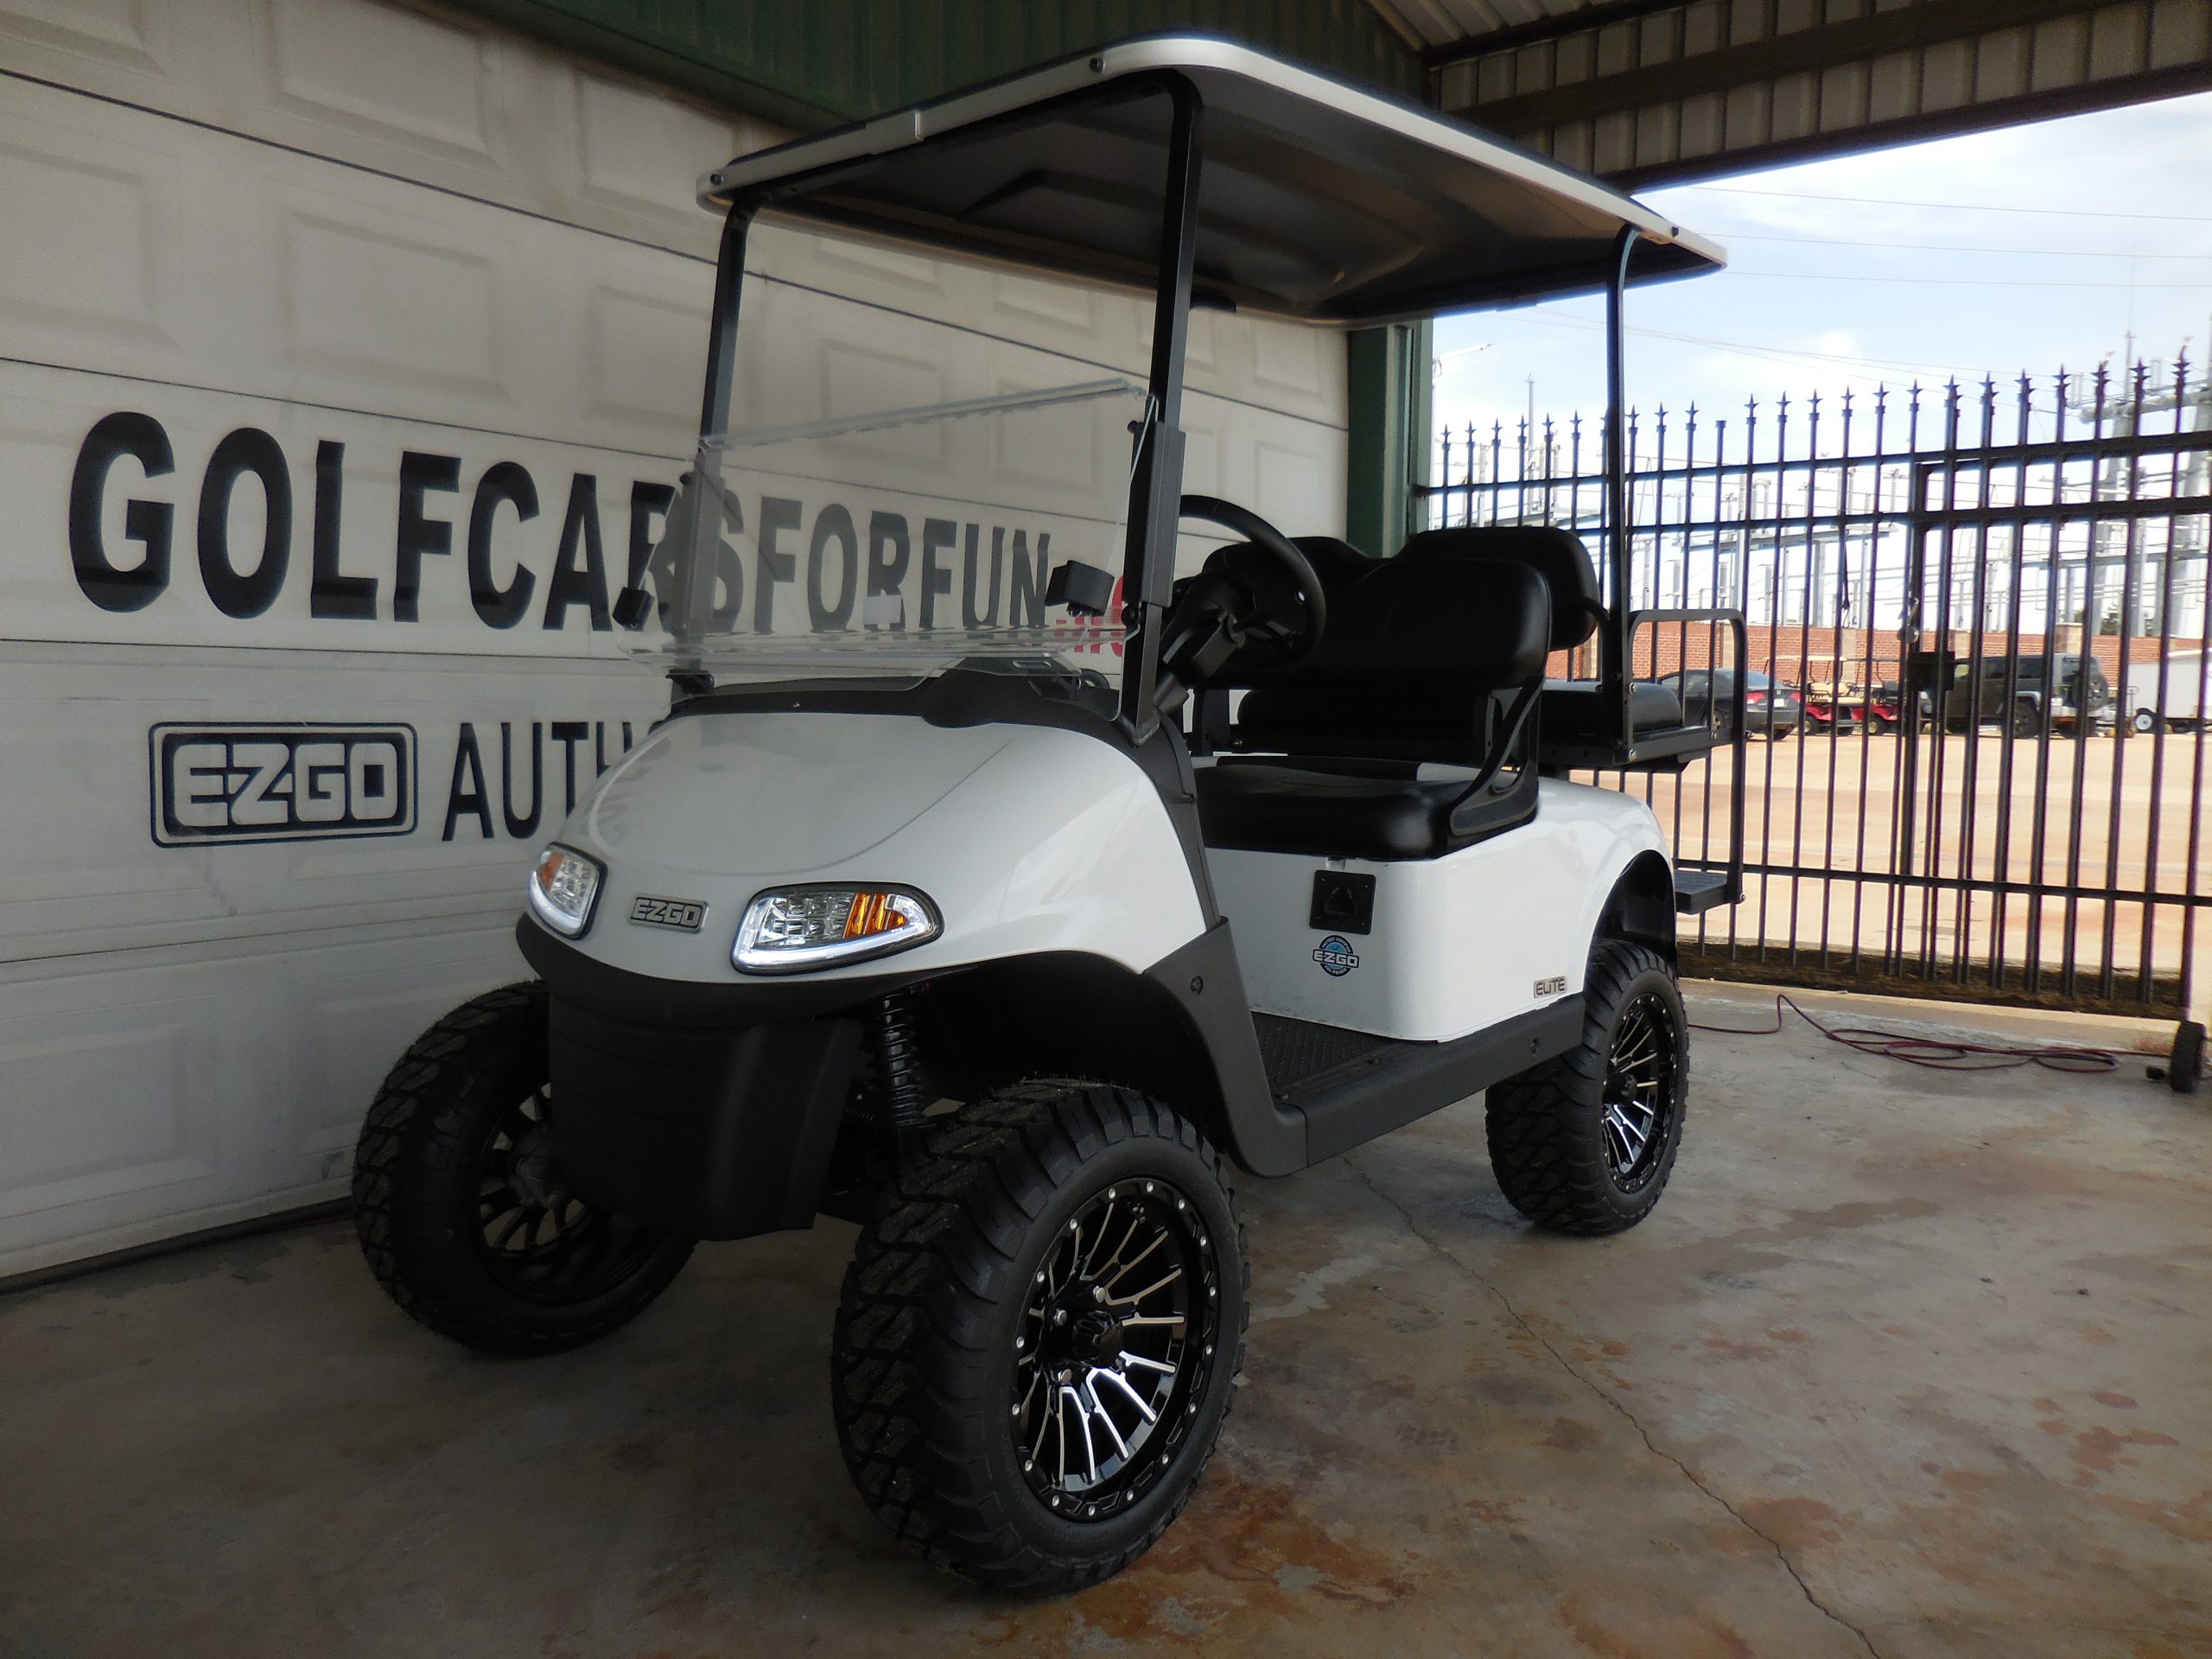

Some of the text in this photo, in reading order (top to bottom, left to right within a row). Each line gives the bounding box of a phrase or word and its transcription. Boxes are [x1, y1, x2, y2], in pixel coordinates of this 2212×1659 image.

[170, 741, 400, 829] EZGO
[632, 898, 702, 927] EZGO
[1313, 950, 1358, 968] EZGO
